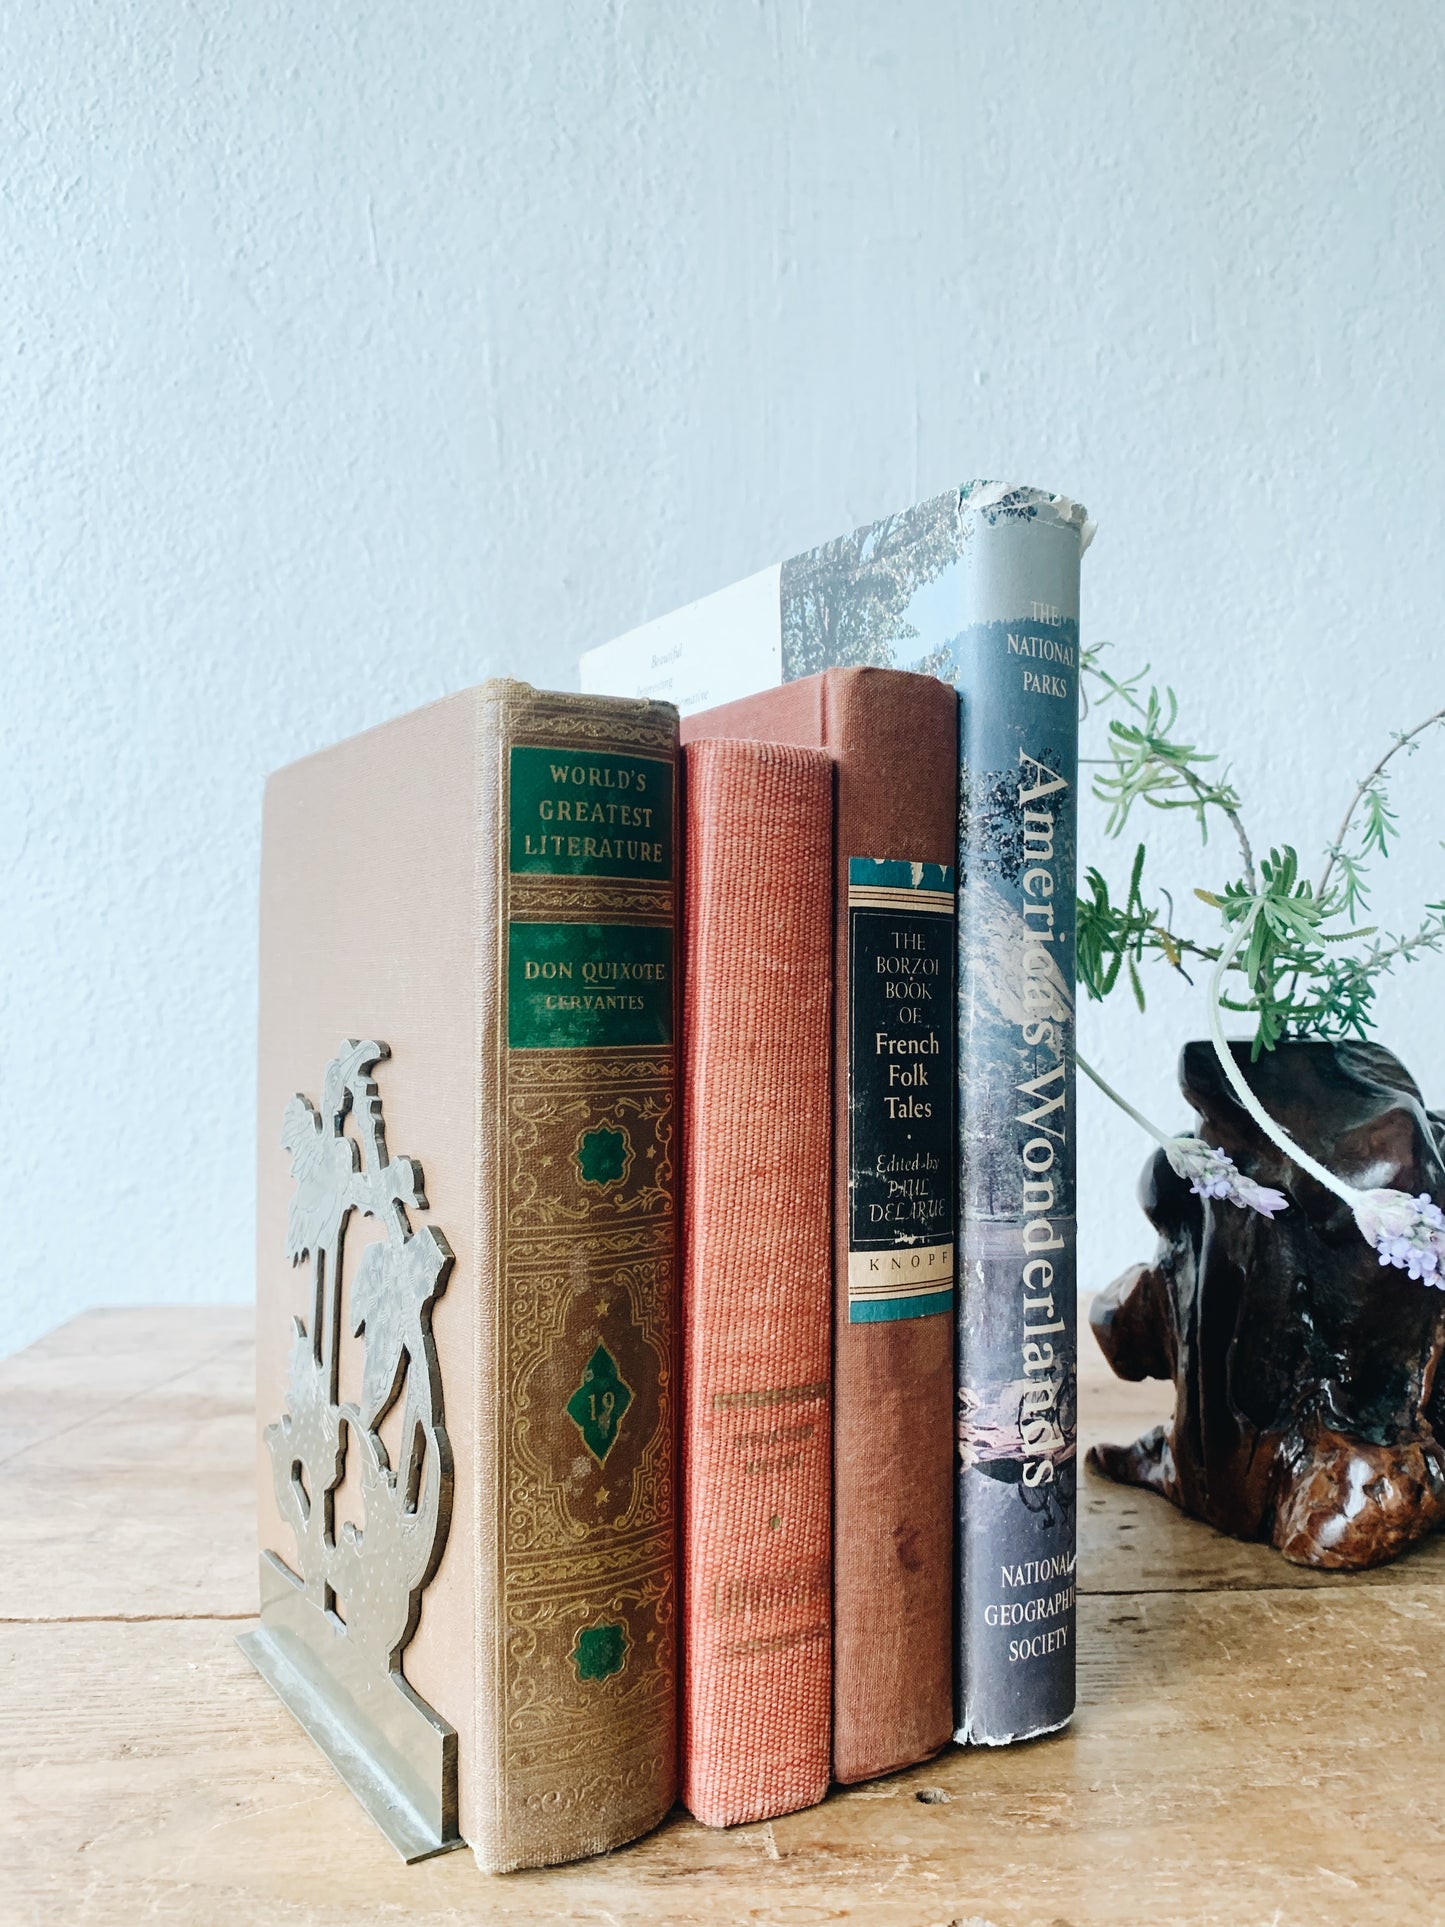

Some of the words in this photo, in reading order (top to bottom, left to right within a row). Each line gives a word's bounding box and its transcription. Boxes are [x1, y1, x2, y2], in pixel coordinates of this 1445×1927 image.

[1031, 601, 1060, 627] THE
[1007, 634, 1075, 668] NATIONAL
[1023, 671, 1067, 698] PARKS
[550, 765, 646, 792] WORLD'S
[539, 801, 653, 828] GREATEST
[525, 835, 663, 863] LITERATURE
[1019, 747, 1068, 1045] America's
[891, 932, 926, 951] THE
[524, 961, 573, 980] DON
[582, 962, 665, 984] QUIXOTE
[876, 956, 939, 976] BORZOI
[546, 996, 645, 1010] CERVANTES
[886, 982, 932, 1000] BOOK
[899, 1007, 922, 1024] OF
[875, 1032, 939, 1055] French
[888, 1063, 928, 1087] Folk
[884, 1096, 932, 1119] Tales
[877, 1152, 919, 1173] Edited
[869, 1199, 946, 1223] DELARUE
[1015, 1057, 1066, 1488] Wonderlands
[588, 1392, 615, 1421] 19
[1000, 1551, 1074, 1588] NATIONAL
[1008, 1625, 1069, 1662] SOCIETY
